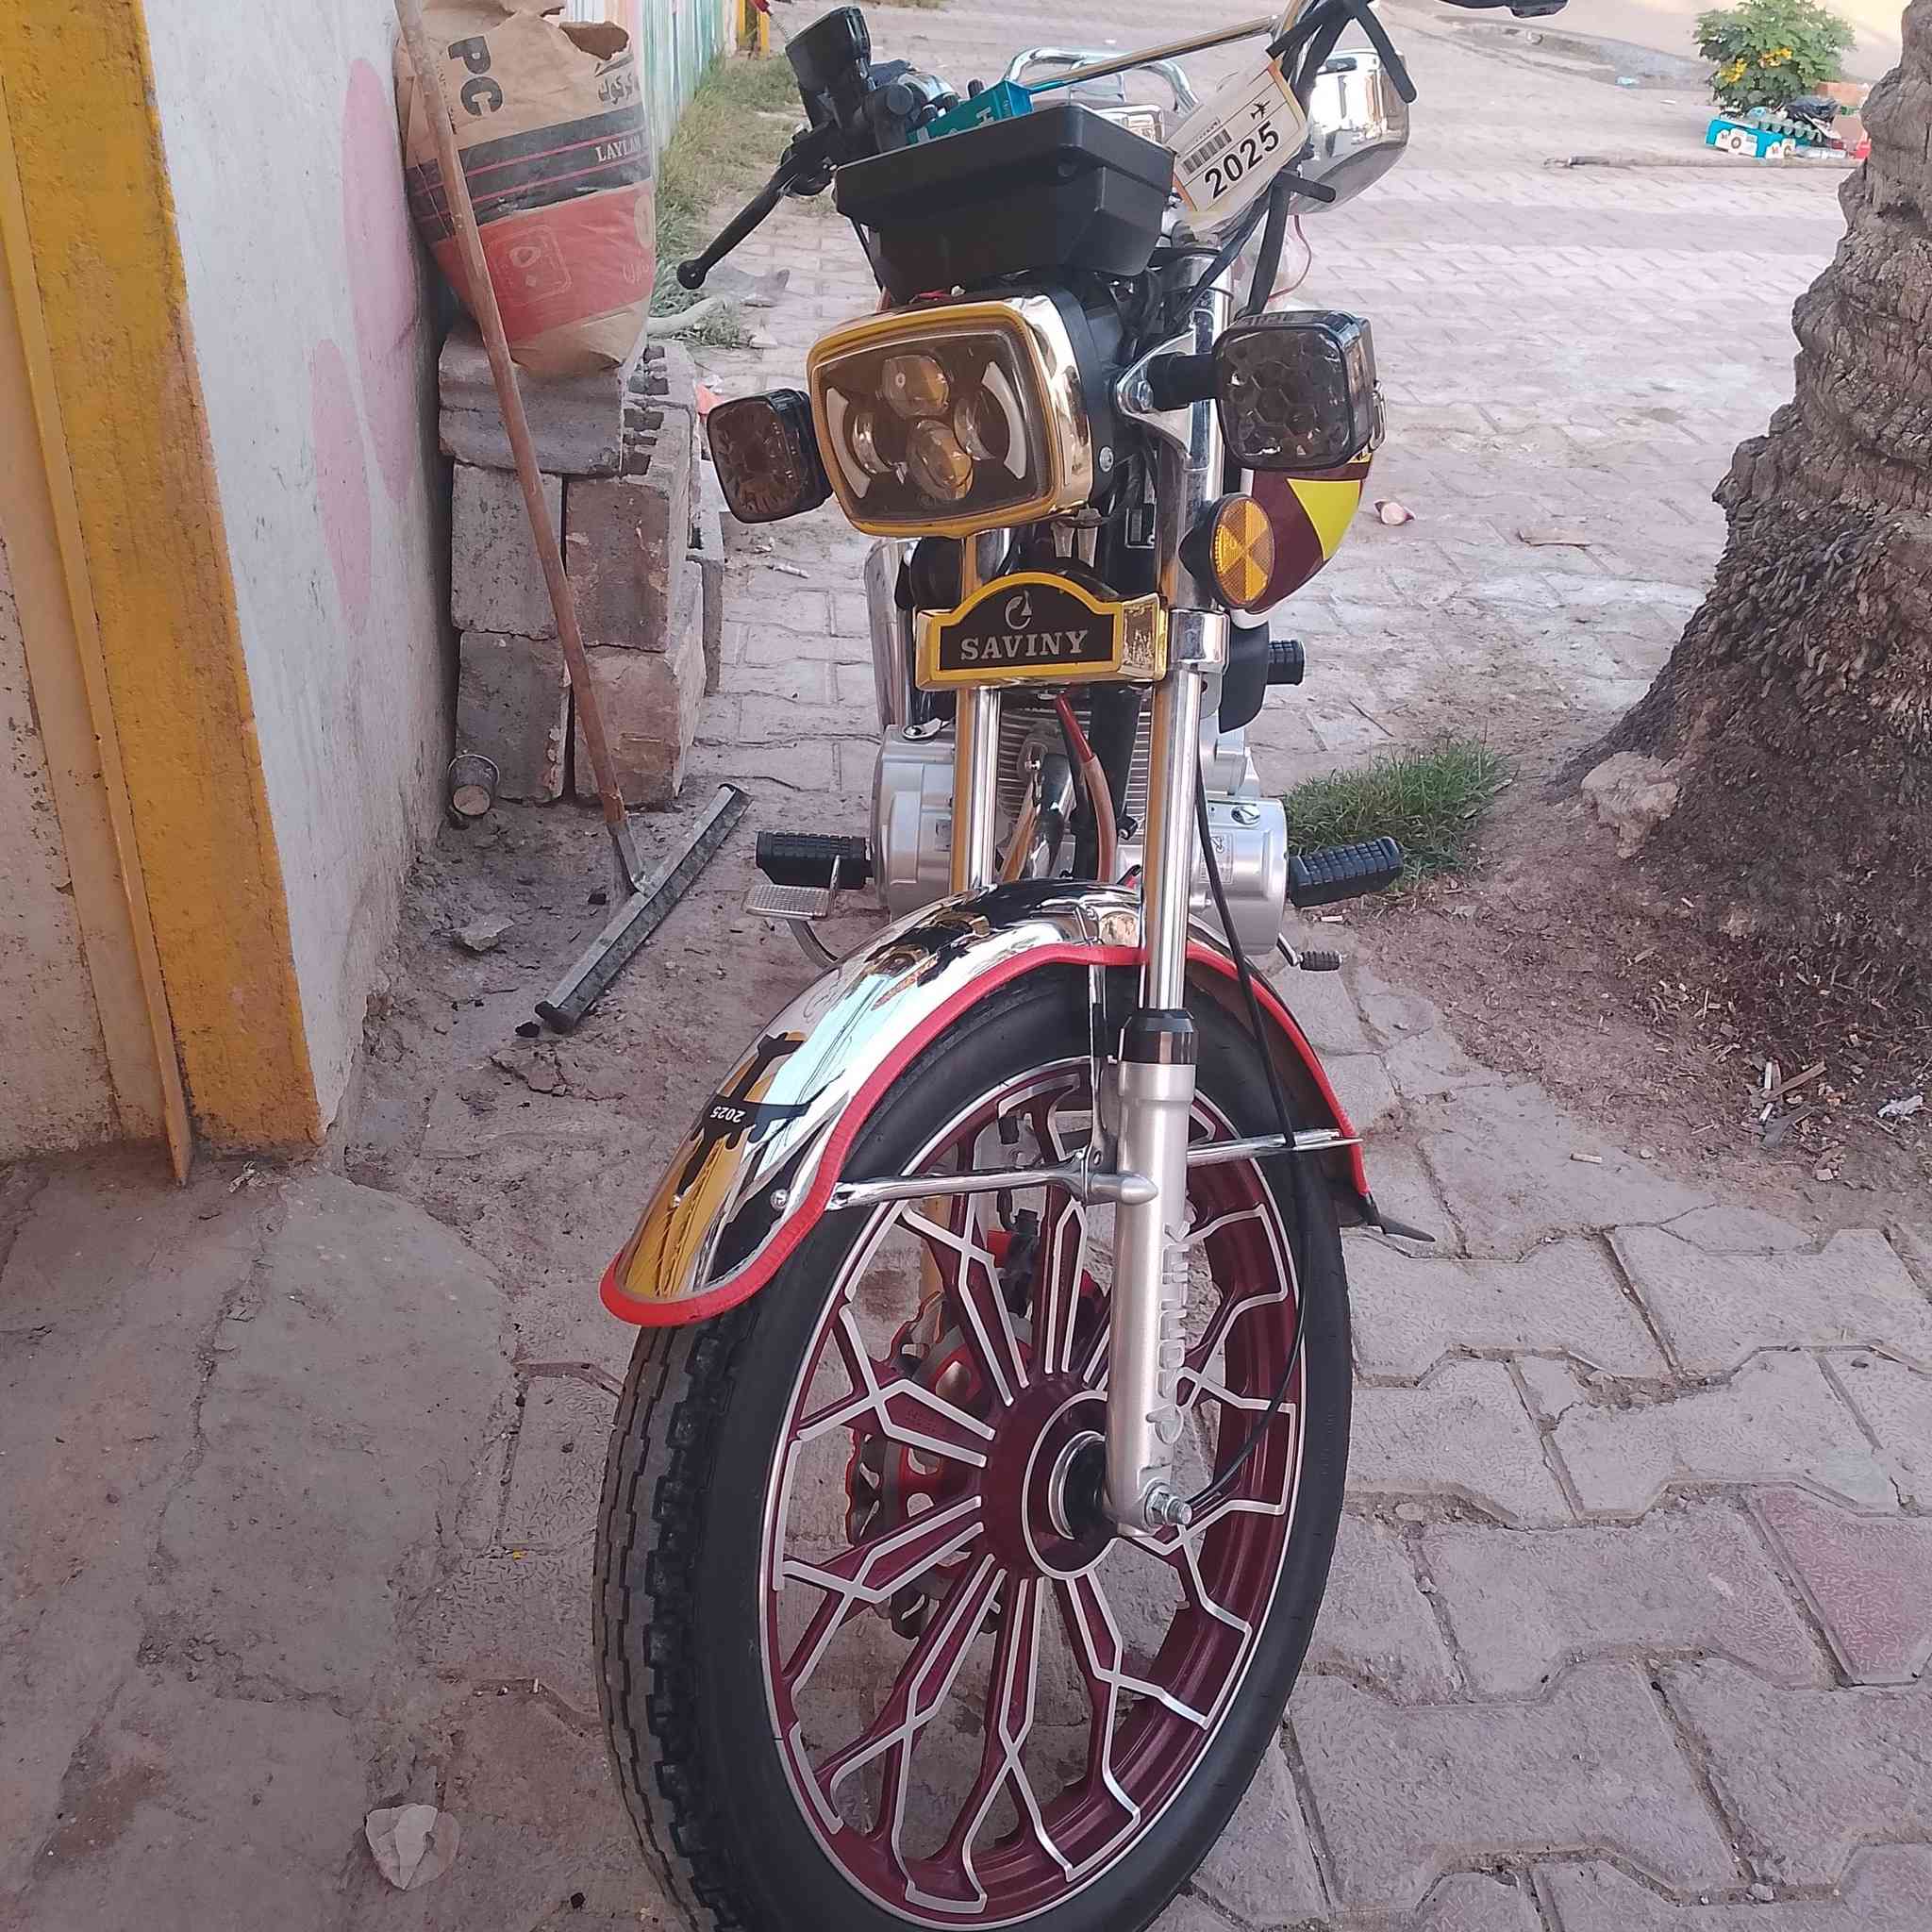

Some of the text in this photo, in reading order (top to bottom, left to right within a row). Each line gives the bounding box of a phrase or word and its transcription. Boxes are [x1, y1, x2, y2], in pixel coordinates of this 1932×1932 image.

[448, 36, 502, 116] PC
[1205, 121, 1279, 199] 2025
[960, 629, 1088, 660] SAVINY
[709, 1106, 746, 1123] 2025
